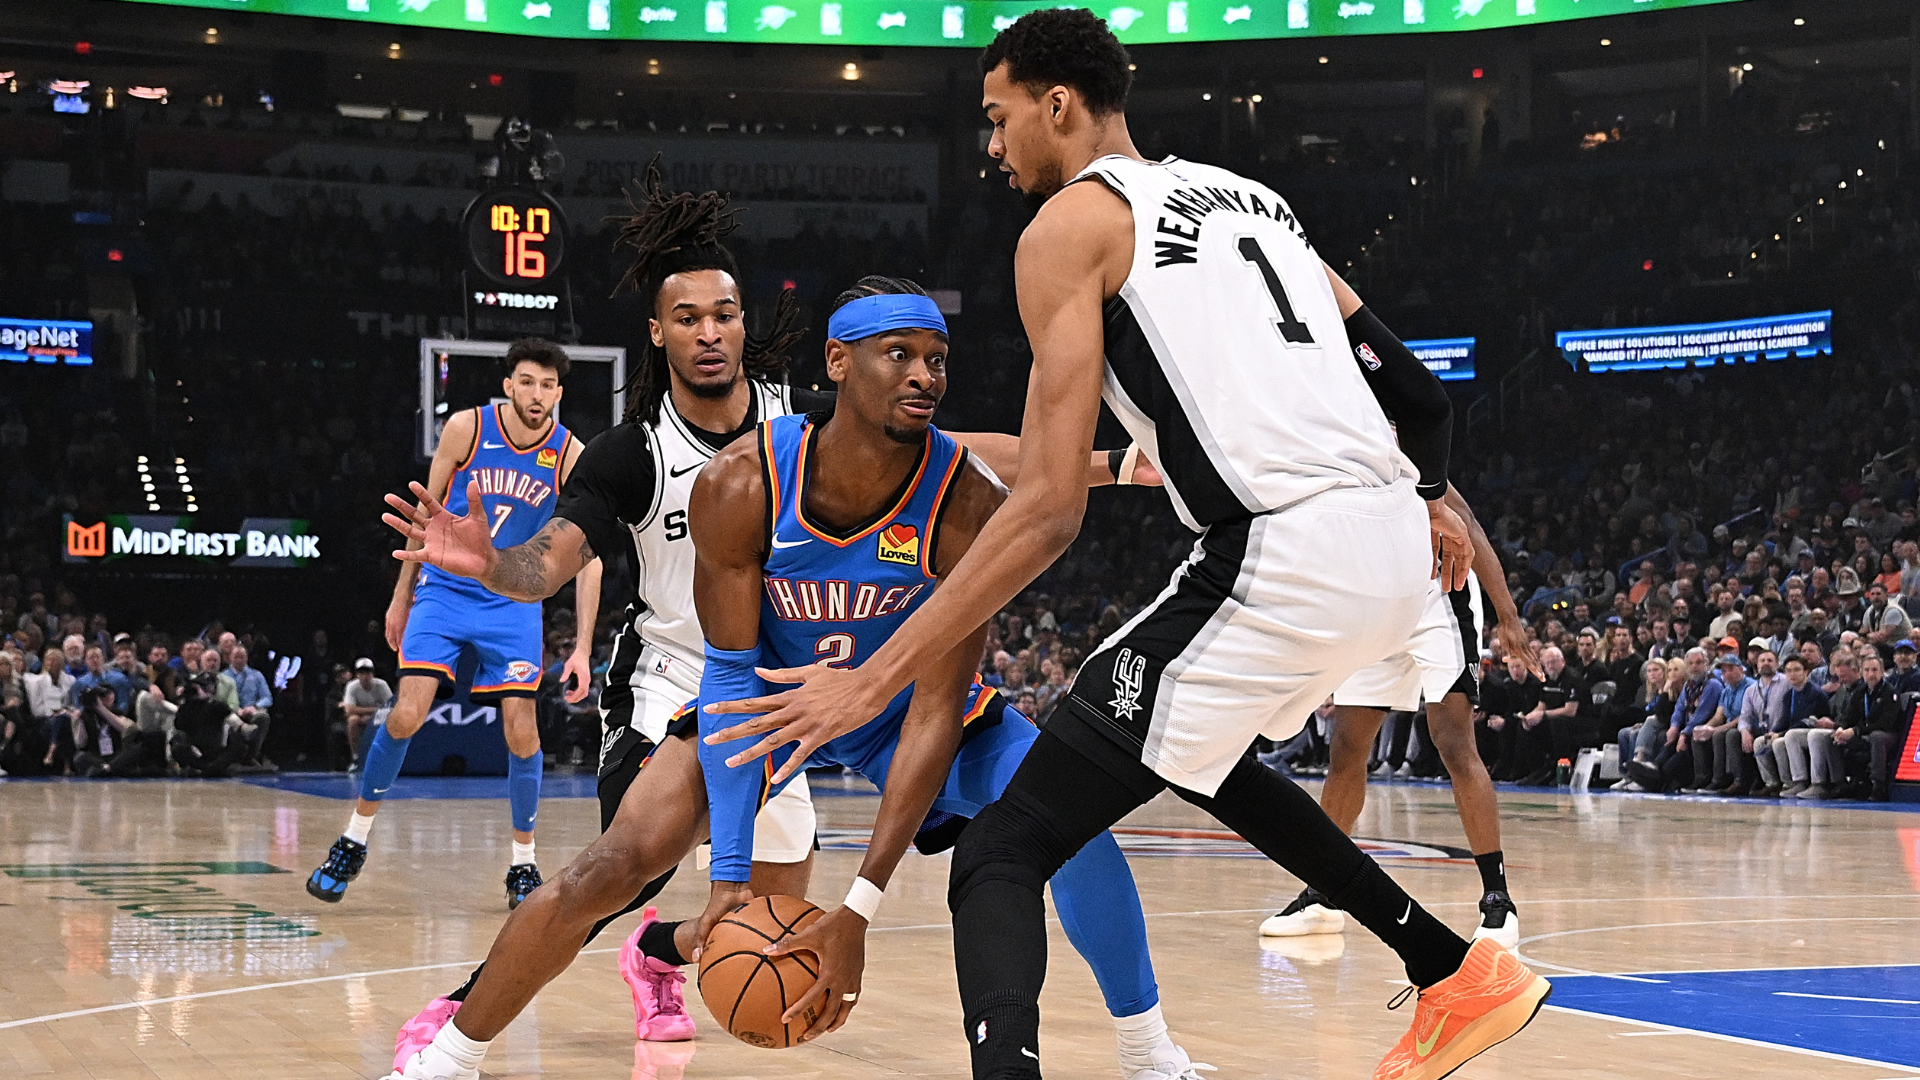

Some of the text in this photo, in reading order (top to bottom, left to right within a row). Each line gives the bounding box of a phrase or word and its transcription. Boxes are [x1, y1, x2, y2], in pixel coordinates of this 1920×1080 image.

[491, 205, 550, 234] 10:17
[505, 231, 545, 278] 16
[497, 292, 558, 310] TISSOT
[1233, 233, 1321, 348] 1
[0, 326, 79, 350] ageNet
[1565, 340, 1596, 352] OFFICE
[1598, 338, 1625, 350] PRINT
[1626, 335, 1677, 348] SOLUTIONS
[1683, 331, 1728, 345] DOCUMENT
[1736, 327, 1772, 340] PROCESS
[1772, 321, 1825, 337] AUTOMATION
[1641, 346, 1704, 360] AUDIO/VISUAL
[1720, 341, 1758, 354] PRINTERS
[1766, 335, 1809, 349] SCANNERS
[470, 467, 552, 508] THUNDER
[490, 503, 514, 539] 7
[763, 574, 927, 622] THUNDER
[815, 632, 855, 670] 2
